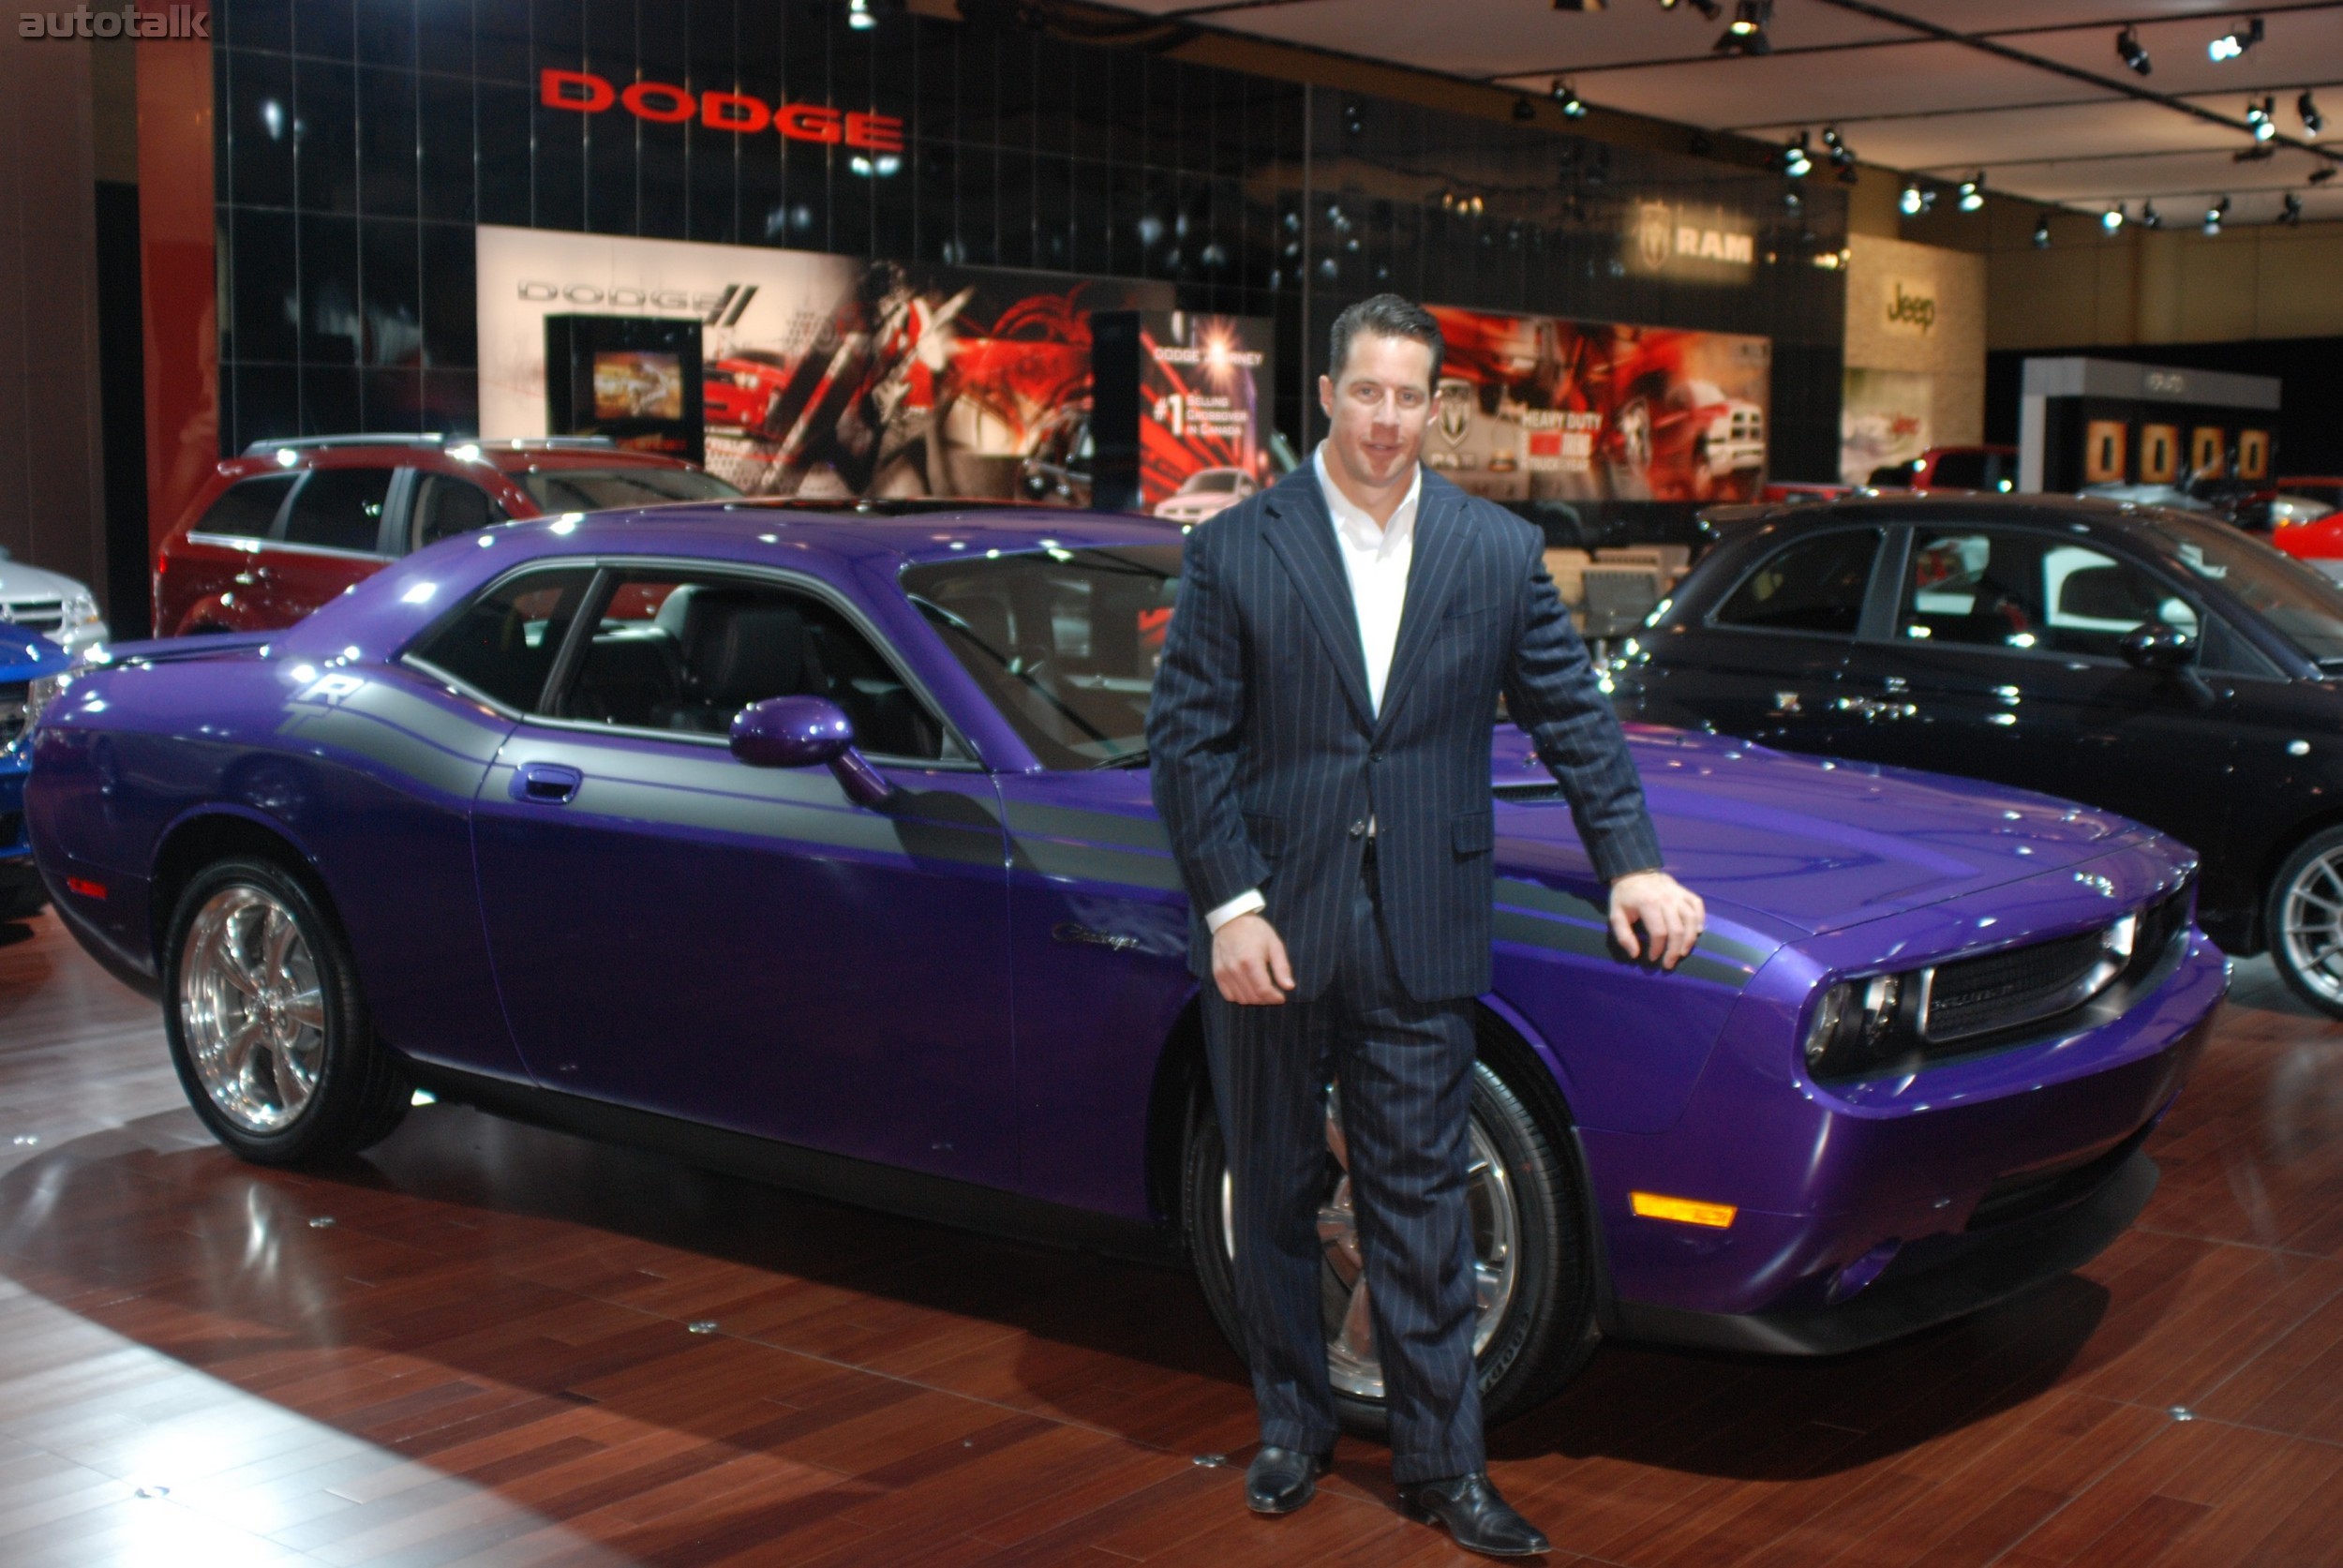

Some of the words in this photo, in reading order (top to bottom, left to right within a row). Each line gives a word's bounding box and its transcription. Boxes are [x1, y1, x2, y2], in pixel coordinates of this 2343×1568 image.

[541, 68, 903, 151] DODGE
[1676, 226, 1754, 264] RAM
[518, 280, 728, 313] DODGE
[1888, 283, 1935, 332] Jeep
[1154, 346, 1200, 364] DODGE
[1203, 351, 1263, 366] JRNEY
[1153, 394, 1183, 437] #1
[1522, 409, 1565, 428] HEAVY
[1567, 412, 1604, 431] DUTY
